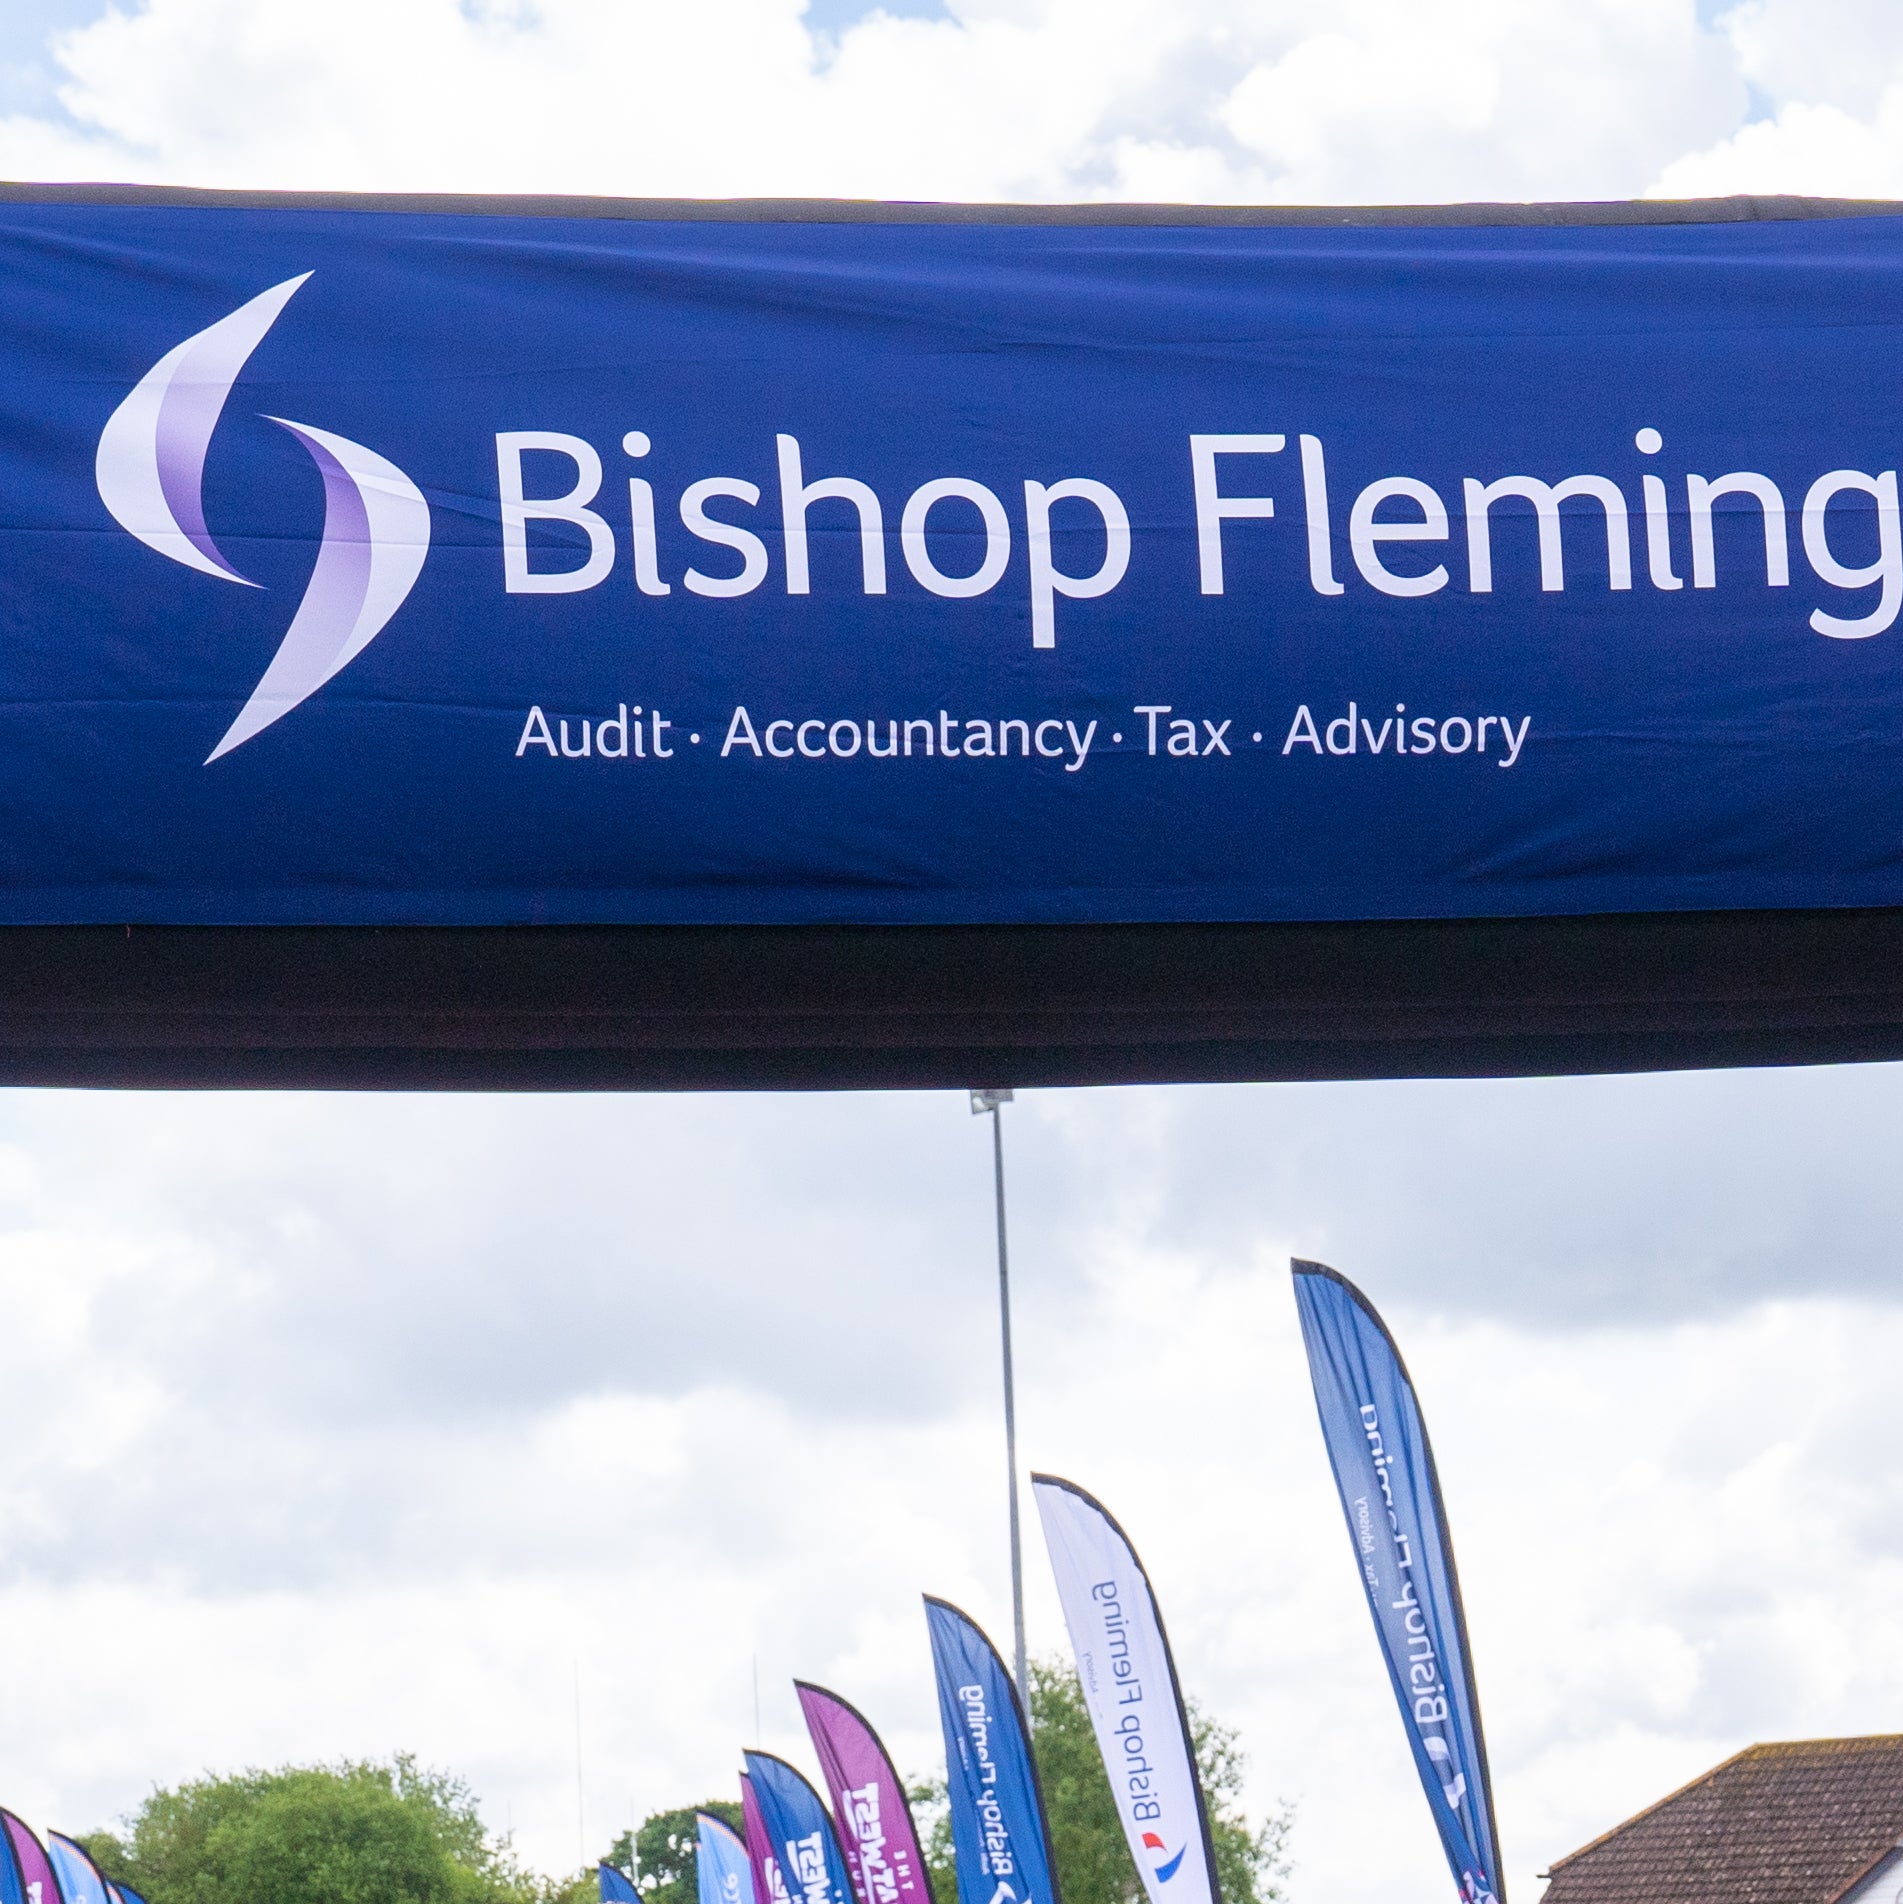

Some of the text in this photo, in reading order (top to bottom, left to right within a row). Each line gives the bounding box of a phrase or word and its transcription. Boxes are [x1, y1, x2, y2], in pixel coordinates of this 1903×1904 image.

[496, 428, 1903, 648] Bishop Fleming
[516, 702, 1531, 772] Audit Accountancy Tax Advisory
